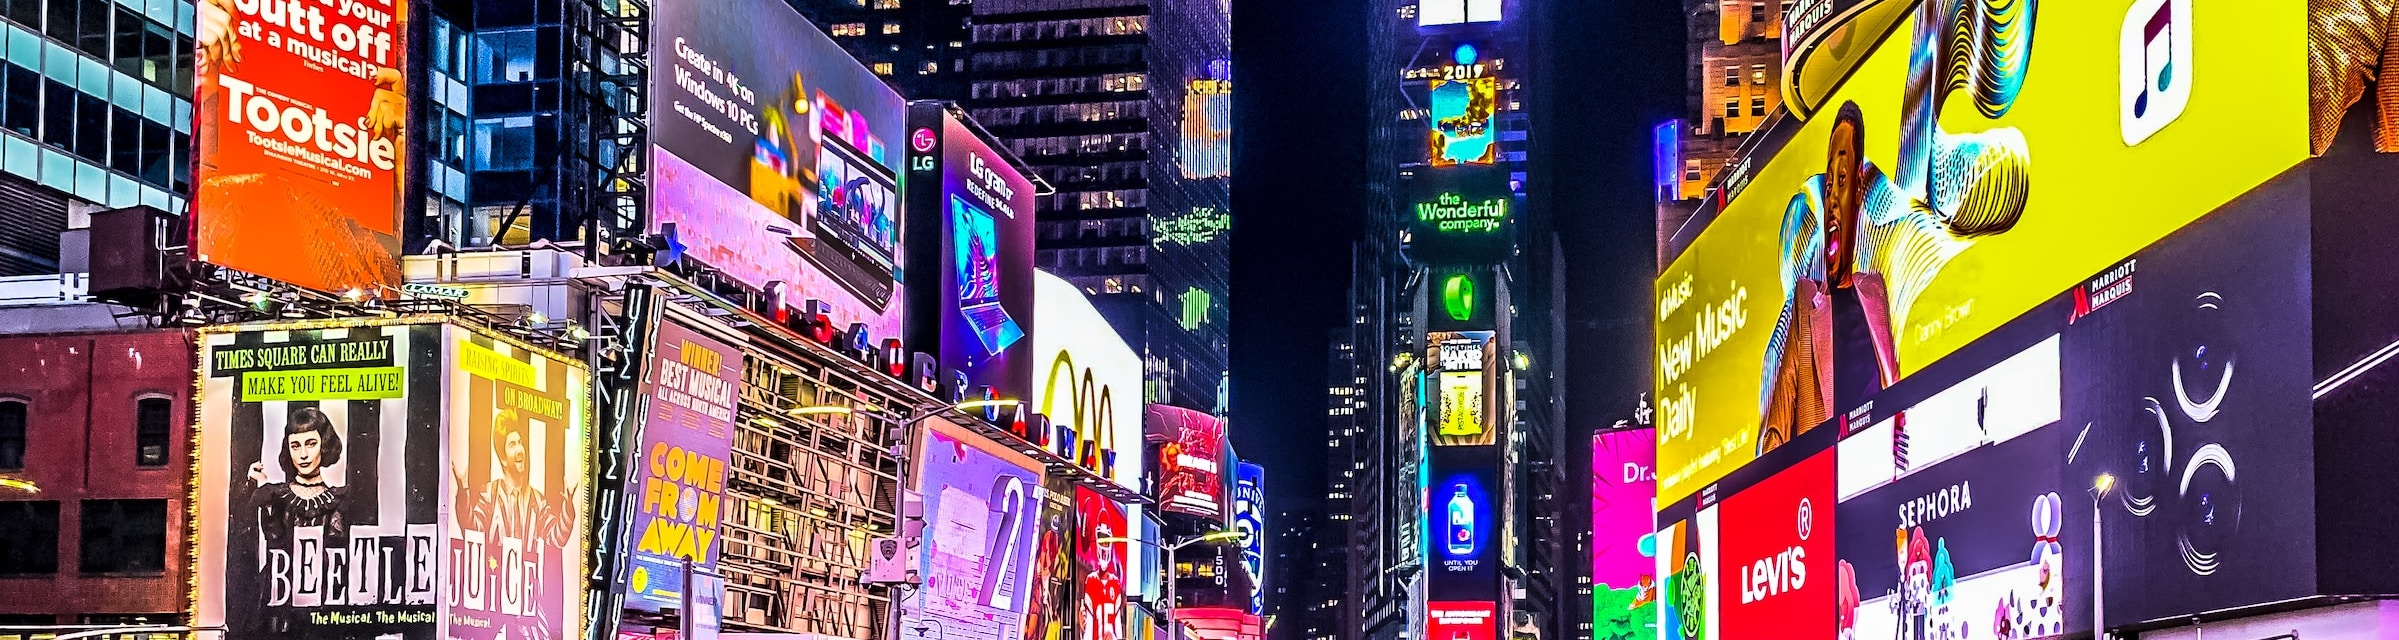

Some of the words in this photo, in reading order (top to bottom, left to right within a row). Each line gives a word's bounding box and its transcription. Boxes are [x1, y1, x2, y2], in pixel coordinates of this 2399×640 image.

[338, 0, 391, 28] your
[237, 20, 262, 42] at
[267, 30, 281, 48] a
[287, 37, 378, 81] musical?
[331, 23, 391, 65] off
[675, 36, 711, 76] Create
[712, 60, 724, 84] in
[726, 72, 739, 96] 4K
[740, 86, 755, 106] on
[1443, 64, 1484, 81] 2019
[674, 63, 726, 113] Windows
[726, 99, 739, 122] 10
[740, 108, 759, 136] PCs
[674, 100, 685, 114] Get
[684, 106, 694, 120] the
[219, 73, 395, 170] Tootsie
[246, 129, 372, 180] TootsieMusical.com
[912, 155, 935, 171] LG
[966, 178, 996, 210] REDEFINE
[970, 151, 984, 180] LG
[984, 167, 1014, 201] gram
[1417, 198, 1505, 221] Wonderful
[1439, 192, 1460, 206] the
[1439, 216, 1496, 233] company
[2091, 259, 2137, 293] MARRIOTT
[2091, 279, 2131, 309] MARQUIS
[1659, 331, 1693, 391] New
[1695, 279, 1748, 363] Music
[216, 349, 254, 371] TIMES
[257, 346, 307, 371] SQUARE
[311, 343, 336, 364] CAN
[340, 340, 389, 362] REALLY
[466, 347, 498, 375] RAISING
[500, 360, 530, 386] SPIRITS
[680, 338, 723, 377] WINNER!
[248, 376, 285, 396] MAKE
[290, 375, 315, 394] YOU
[321, 374, 352, 393] FEEL
[357, 372, 400, 393] ALIVE!
[657, 385, 670, 402] ALL
[669, 389, 692, 409] ACROSS
[660, 357, 689, 393] BEST
[688, 368, 733, 409] MUSICAL
[504, 386, 517, 406] ON
[517, 390, 563, 420] BROADWAY!
[1660, 382, 1697, 446] Daily
[650, 441, 725, 494] COME
[644, 476, 720, 529] FROM
[1898, 480, 1972, 530] SEPHORA
[637, 516, 715, 564] AWAY
[267, 536, 433, 607] BEETLE
[1215, 545, 1224, 585] 1500
[310, 611, 329, 625] The
[330, 610, 373, 625] Musical.
[376, 611, 395, 624] The
[397, 610, 436, 624] Musical
[449, 612, 462, 627] The
[1095, 603, 1116, 640] 15
